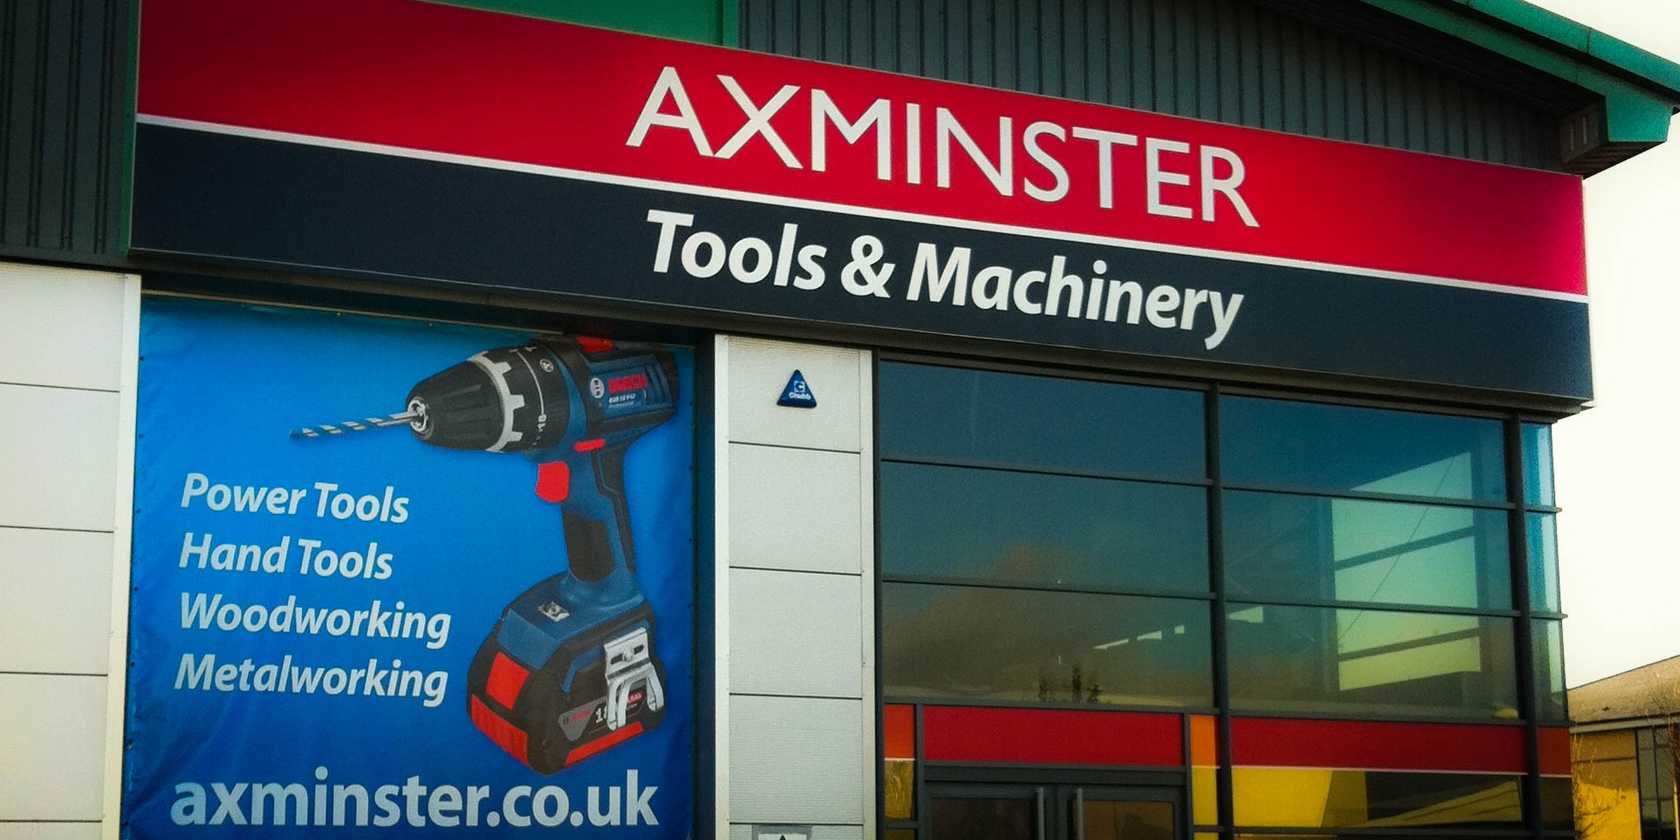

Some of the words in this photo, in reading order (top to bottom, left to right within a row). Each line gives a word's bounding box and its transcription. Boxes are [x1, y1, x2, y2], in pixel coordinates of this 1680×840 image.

[626, 66, 1260, 228] AXMINSTER
[646, 209, 828, 290] Tools
[841, 234, 896, 299] &
[906, 243, 1244, 350] Machinery
[181, 473, 307, 515] Power
[314, 482, 410, 524] Tools
[179, 533, 291, 574] Hand
[298, 538, 394, 580] Tools
[181, 592, 452, 650] Woodworking
[174, 653, 449, 708] Metalworking
[171, 766, 660, 828] axminster.co.uk
